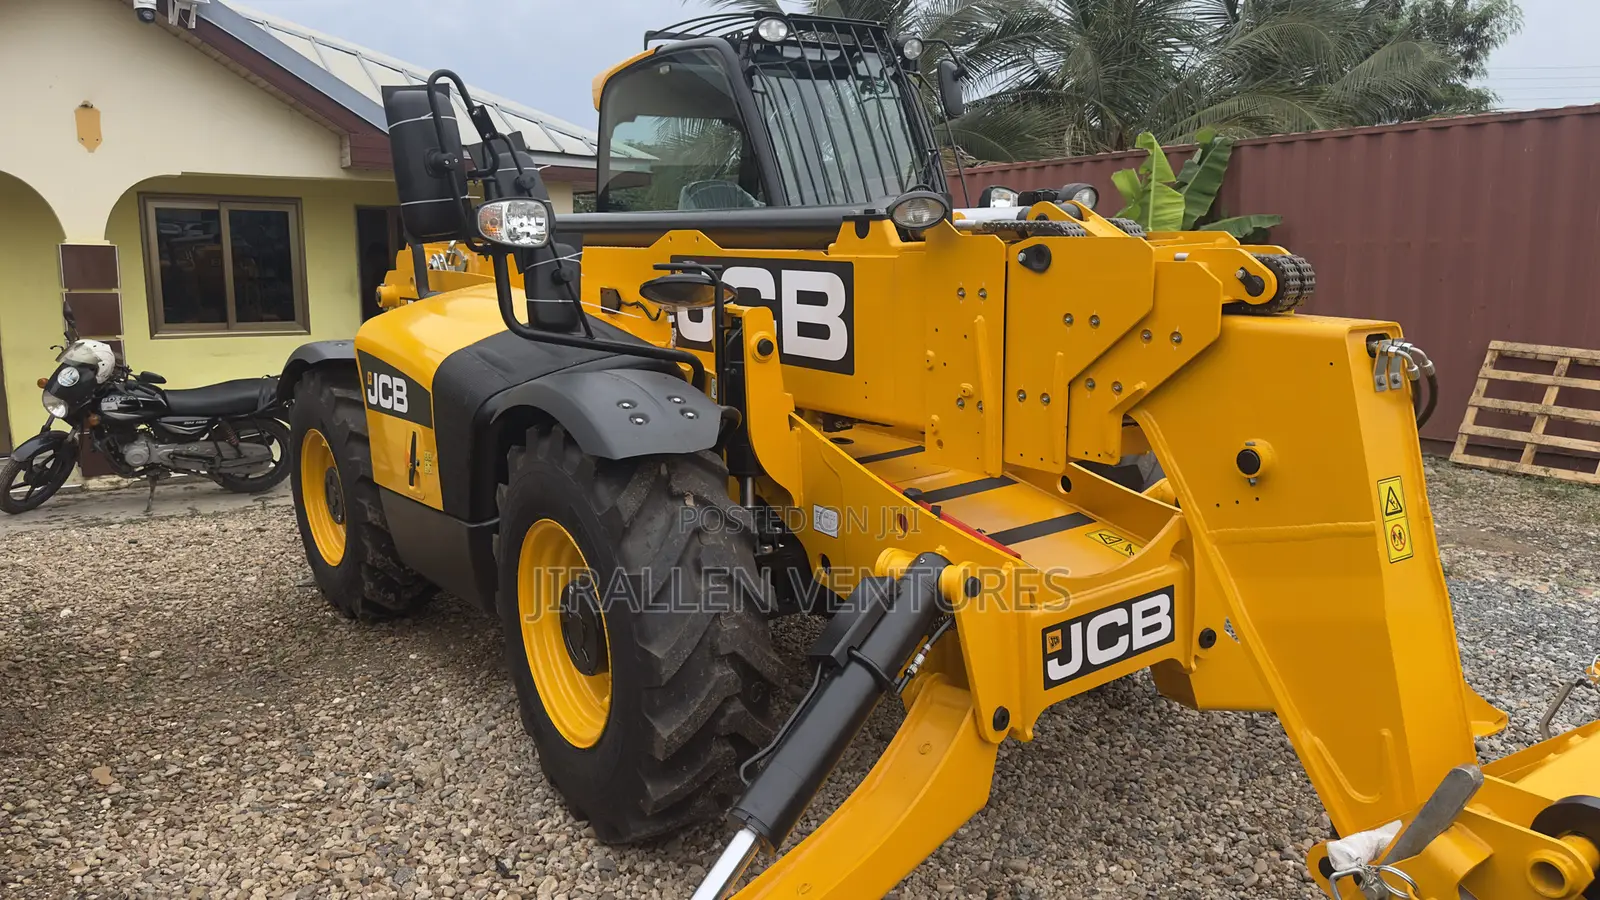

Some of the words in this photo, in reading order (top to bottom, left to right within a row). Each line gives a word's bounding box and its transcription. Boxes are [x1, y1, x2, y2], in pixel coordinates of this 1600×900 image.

[101, 395, 137, 404] BOXER
[367, 372, 409, 414] JCB
[1047, 593, 1172, 681] JCB
